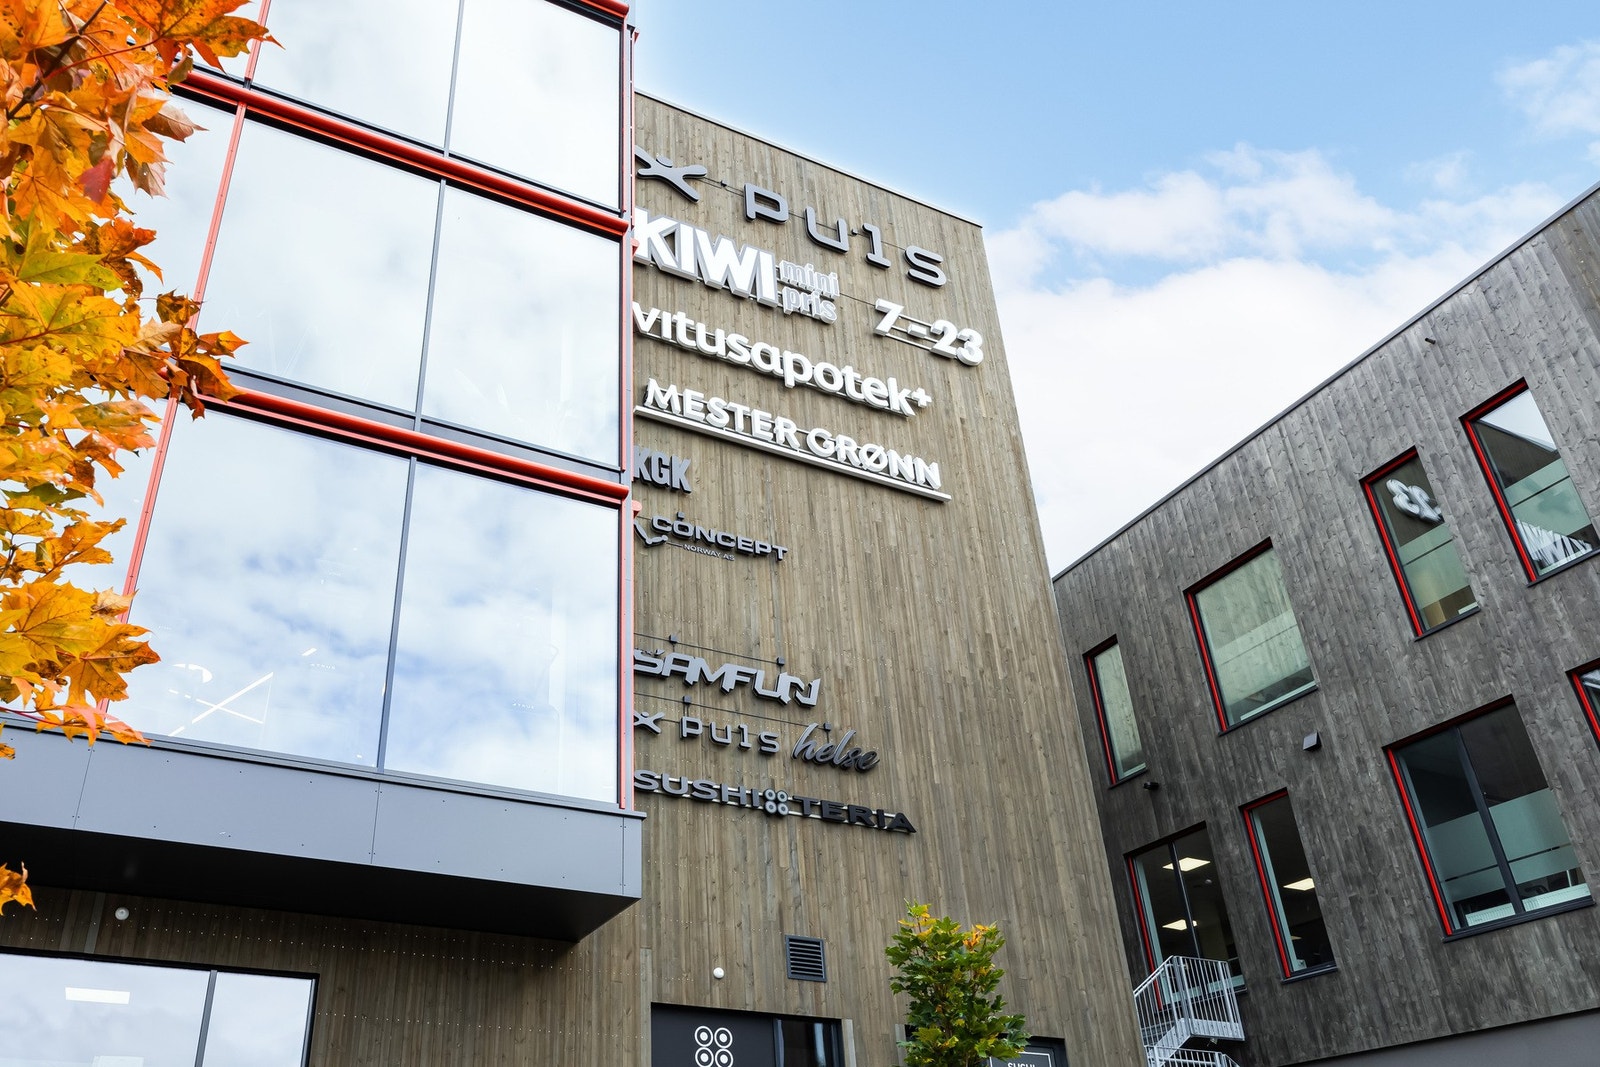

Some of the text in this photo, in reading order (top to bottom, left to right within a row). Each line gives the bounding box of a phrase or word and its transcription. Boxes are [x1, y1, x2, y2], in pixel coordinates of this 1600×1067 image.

[633, 206, 778, 308] KIWI
[779, 259, 840, 299] mini
[782, 289, 837, 325] pris
[643, 378, 942, 490] MESTER GRØNN
[634, 447, 692, 494] KGK
[652, 515, 788, 561] CONCEPT
[683, 543, 735, 562] NORWAY AS
[791, 722, 880, 773] helse
[634, 769, 917, 834] SUSHI TERIA
